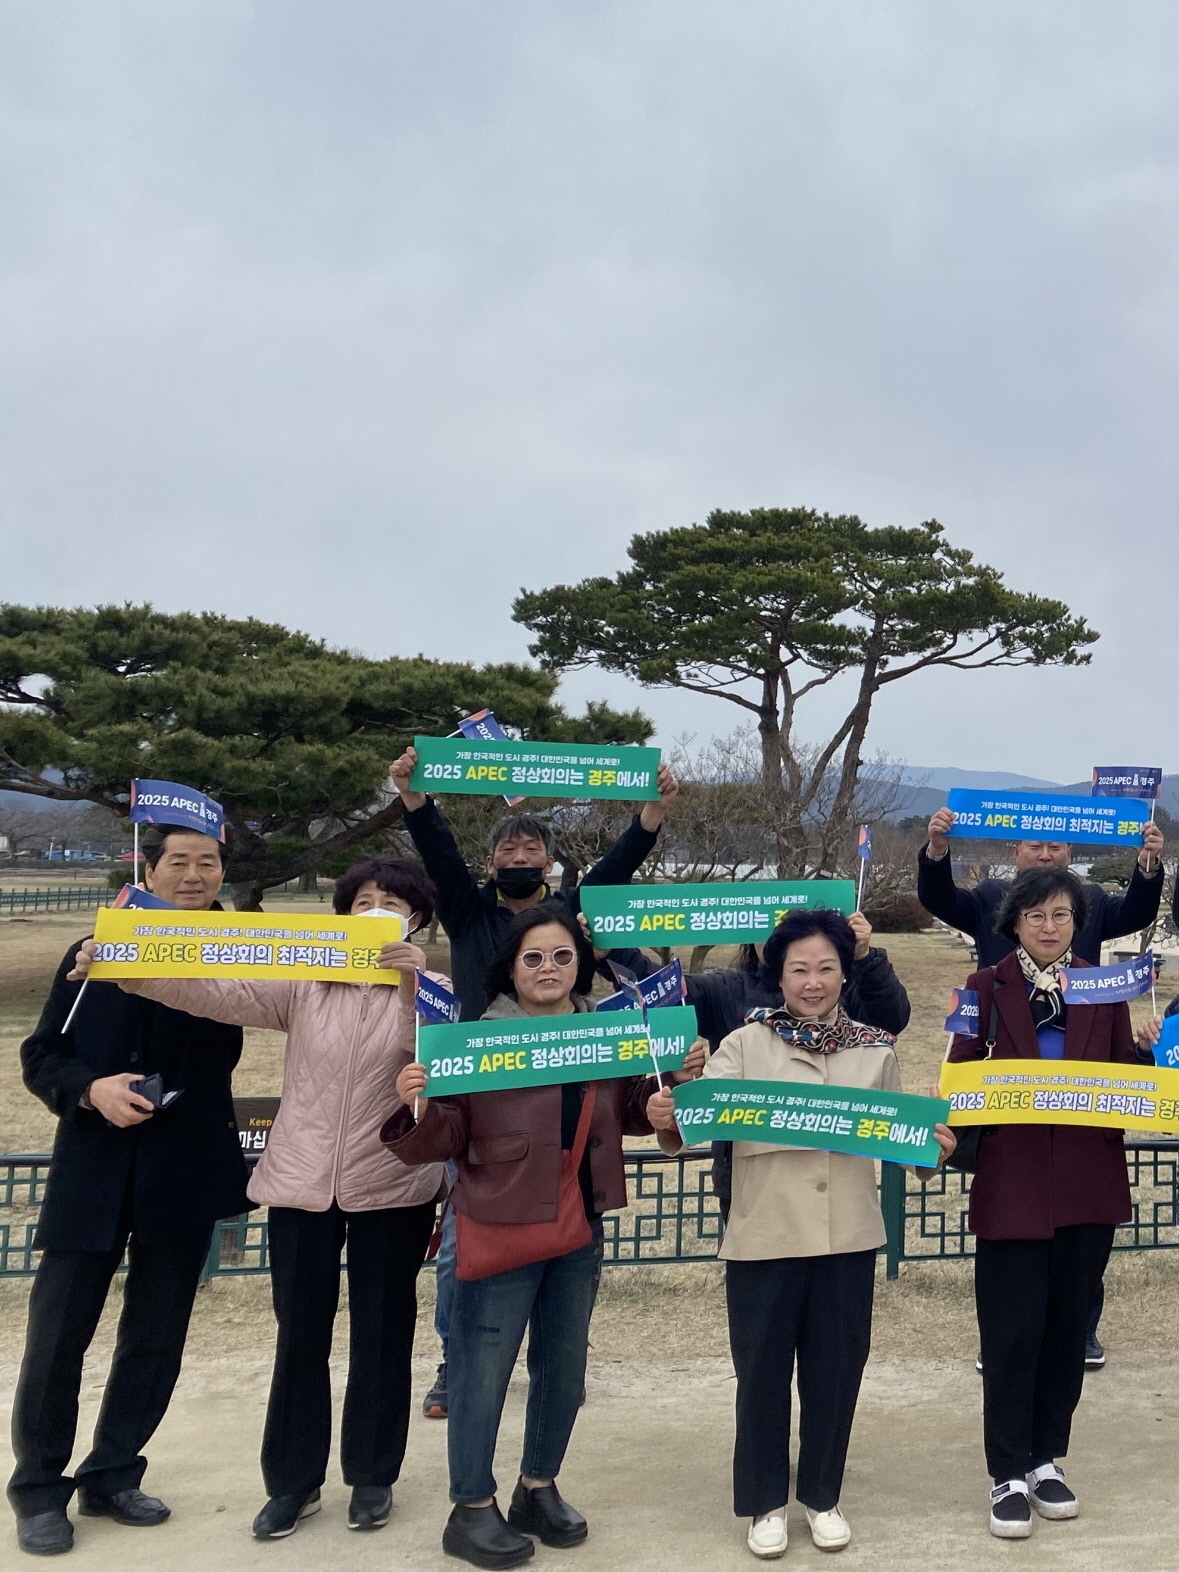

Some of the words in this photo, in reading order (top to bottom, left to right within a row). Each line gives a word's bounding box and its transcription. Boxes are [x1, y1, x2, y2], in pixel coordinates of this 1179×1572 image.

[476, 722, 496, 741] 202
[456, 751, 472, 760] 가장
[473, 752, 504, 761] 한국적인
[505, 753, 520, 761] 도시
[521, 754, 539, 762] 경주!
[541, 755, 578, 765] 대한민국을
[579, 756, 594, 766] 넘어
[596, 757, 620, 766] 세계로!
[424, 764, 461, 779] 2025
[466, 766, 507, 781] APEC
[512, 767, 583, 785] 정상회의는
[588, 769, 649, 787] 경주에서!
[1098, 777, 1114, 785] 2025
[1114, 777, 1132, 785] APEC
[1140, 777, 1155, 786] 경주
[138, 794, 169, 806] 2025
[171, 797, 199, 813] APEC
[206, 809, 218, 823] 경주
[953, 812, 982, 826] 2025
[985, 814, 1017, 828] APEC
[1021, 817, 1066, 832] 정상회의
[1069, 818, 1114, 835] 최적지는
[1117, 822, 1143, 836] 경주!
[628, 900, 645, 909] 가장
[647, 899, 680, 908] 한국적인
[681, 899, 698, 907] 도시
[700, 898, 719, 907] 경주!
[721, 896, 761, 906] 대한민국을
[763, 896, 779, 905] 넘어
[781, 895, 808, 904] 세계로!
[594, 916, 635, 933] 2025
[639, 914, 685, 931] APEC
[690, 911, 769, 931] 정상회의는
[93, 943, 138, 962] 2025
[143, 944, 196, 962] APEC
[201, 944, 272, 964] 정상회의
[277, 947, 347, 967] 최적지는
[664, 975, 677, 991] 경주
[1071, 980, 1096, 990] 2025
[1097, 975, 1125, 989] APEC
[1135, 965, 1150, 980] 경주
[418, 987, 433, 1005] 2025
[434, 997, 449, 1016] APEC
[466, 1038, 483, 1048] 가장
[486, 1035, 519, 1047] 한국적인
[522, 1034, 539, 1043] 도시
[541, 1032, 560, 1042] 경주!
[563, 1027, 604, 1040] 대한민국을
[606, 1026, 622, 1036] 넘어
[431, 1056, 474, 1077] 2025
[479, 1052, 526, 1073] APEC
[531, 1044, 613, 1069] 정상회의는
[617, 1036, 685, 1061] 경주에서!
[711, 1093, 730, 1102] 가장
[731, 1093, 765, 1103] 한국적인
[767, 1095, 785, 1104] 도시
[786, 1096, 806, 1106] 경주!
[807, 1097, 850, 1111] 대한민국을
[851, 1102, 869, 1113] 넘어
[869, 1104, 898, 1117] 세계로!
[949, 1093, 985, 1111] 2025
[988, 1091, 1029, 1109] APEC
[1033, 1091, 1093, 1112] 정상회의
[1095, 1094, 1156, 1117] 최적지는
[249, 1118, 273, 1127] Keep
[675, 1108, 714, 1126] 2025
[717, 1109, 767, 1126] APEC
[770, 1110, 853, 1136] 정상회의는
[857, 1118, 928, 1147] 경주에서!
